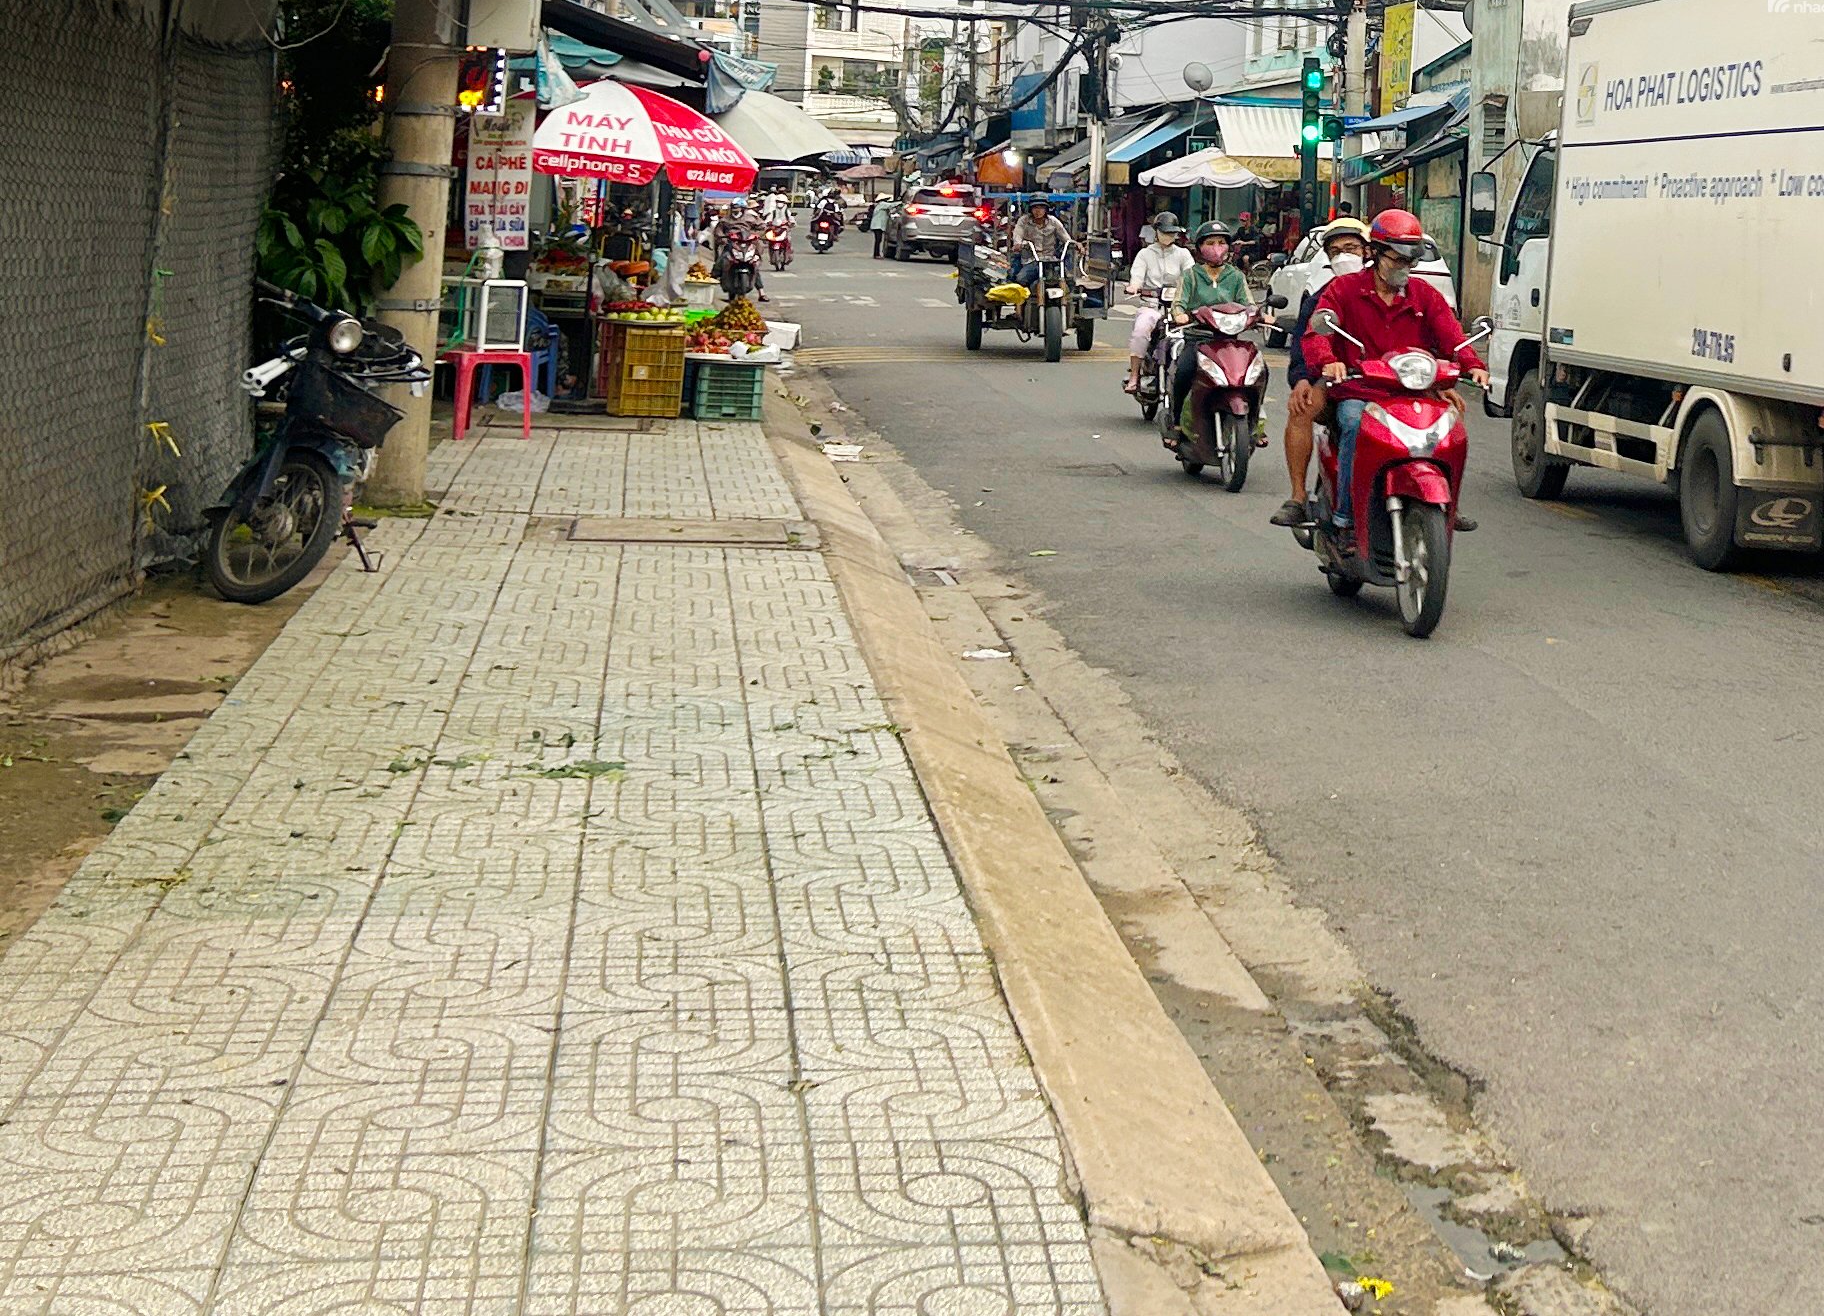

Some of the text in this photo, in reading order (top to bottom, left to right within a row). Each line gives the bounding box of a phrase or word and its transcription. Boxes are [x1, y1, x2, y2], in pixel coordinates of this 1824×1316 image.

[1604, 78, 1633, 112] HOA
[1636, 72, 1676, 108] PHAT
[1677, 59, 1763, 105] LOGISTICS
[566, 111, 634, 132] MÁY
[654, 121, 694, 141] THU
[559, 131, 633, 155] TÍNH
[537, 153, 641, 179] cellphone S
[700, 148, 744, 166] MỚI
[1779, 168, 1806, 198] Low
